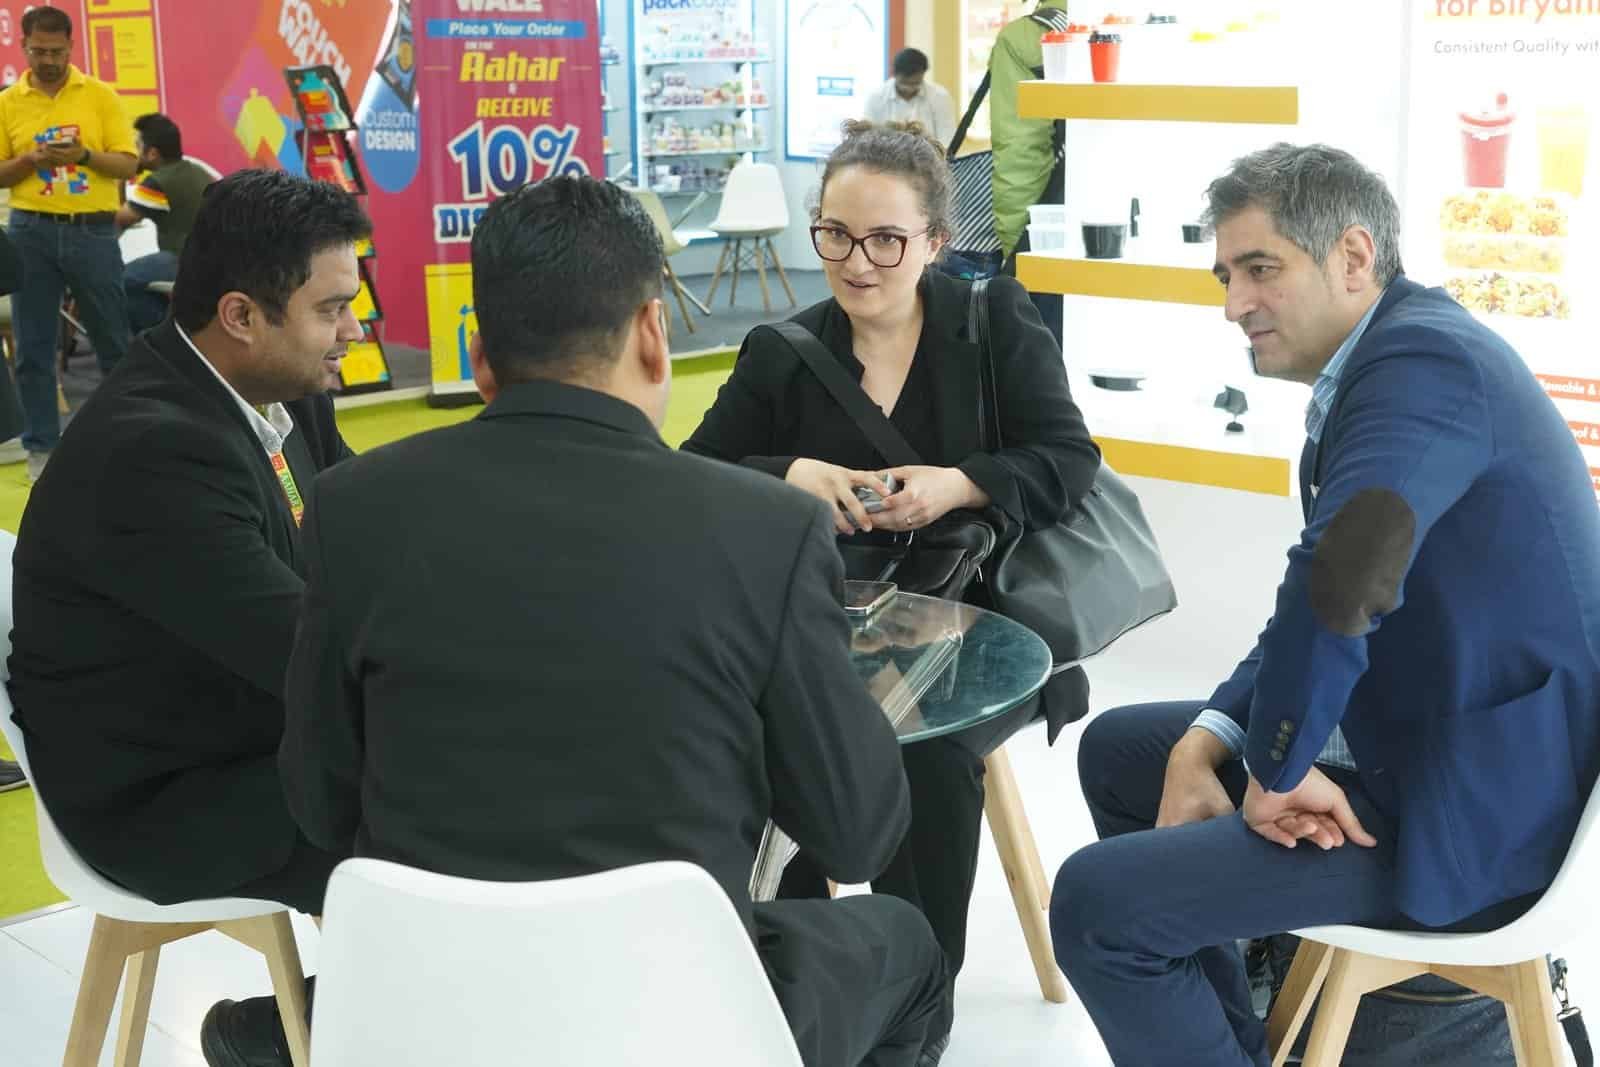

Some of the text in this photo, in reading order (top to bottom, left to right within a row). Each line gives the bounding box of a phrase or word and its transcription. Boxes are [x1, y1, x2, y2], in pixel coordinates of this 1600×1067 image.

[493, 22, 523, 35] Your
[526, 22, 566, 35] Order
[1434, 40, 1507, 54] Consistent
[1512, 39, 1569, 56] Quality
[475, 97, 553, 118] RECEIVE
[366, 130, 416, 151] DESIGN
[447, 120, 591, 200] 10%
